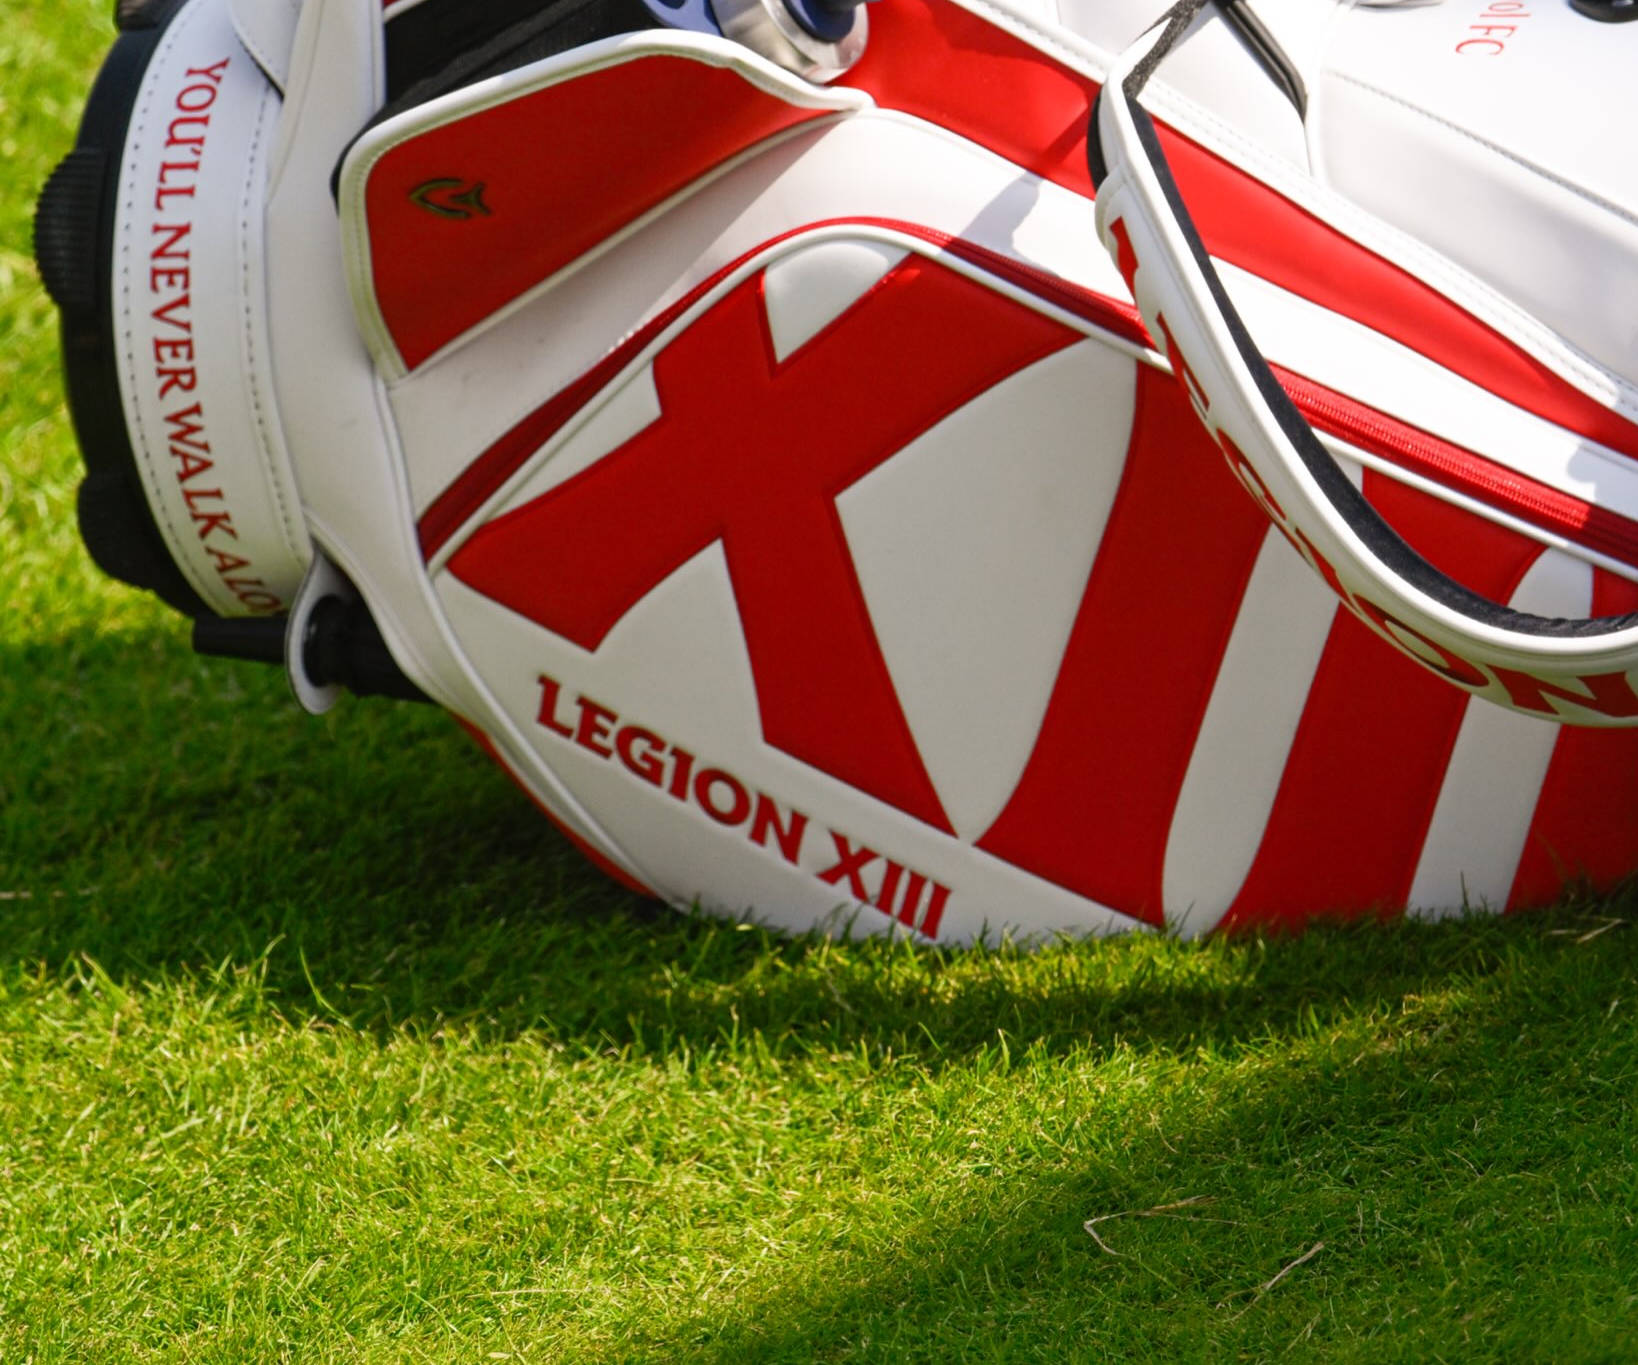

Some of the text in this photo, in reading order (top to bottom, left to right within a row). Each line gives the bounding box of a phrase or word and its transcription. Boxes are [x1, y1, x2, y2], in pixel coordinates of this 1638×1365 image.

[1454, 25, 1519, 56] FC
[150, 56, 290, 617] YOU'LL NEVER WALK ALO
[535, 664, 953, 941] LEGION XIII
